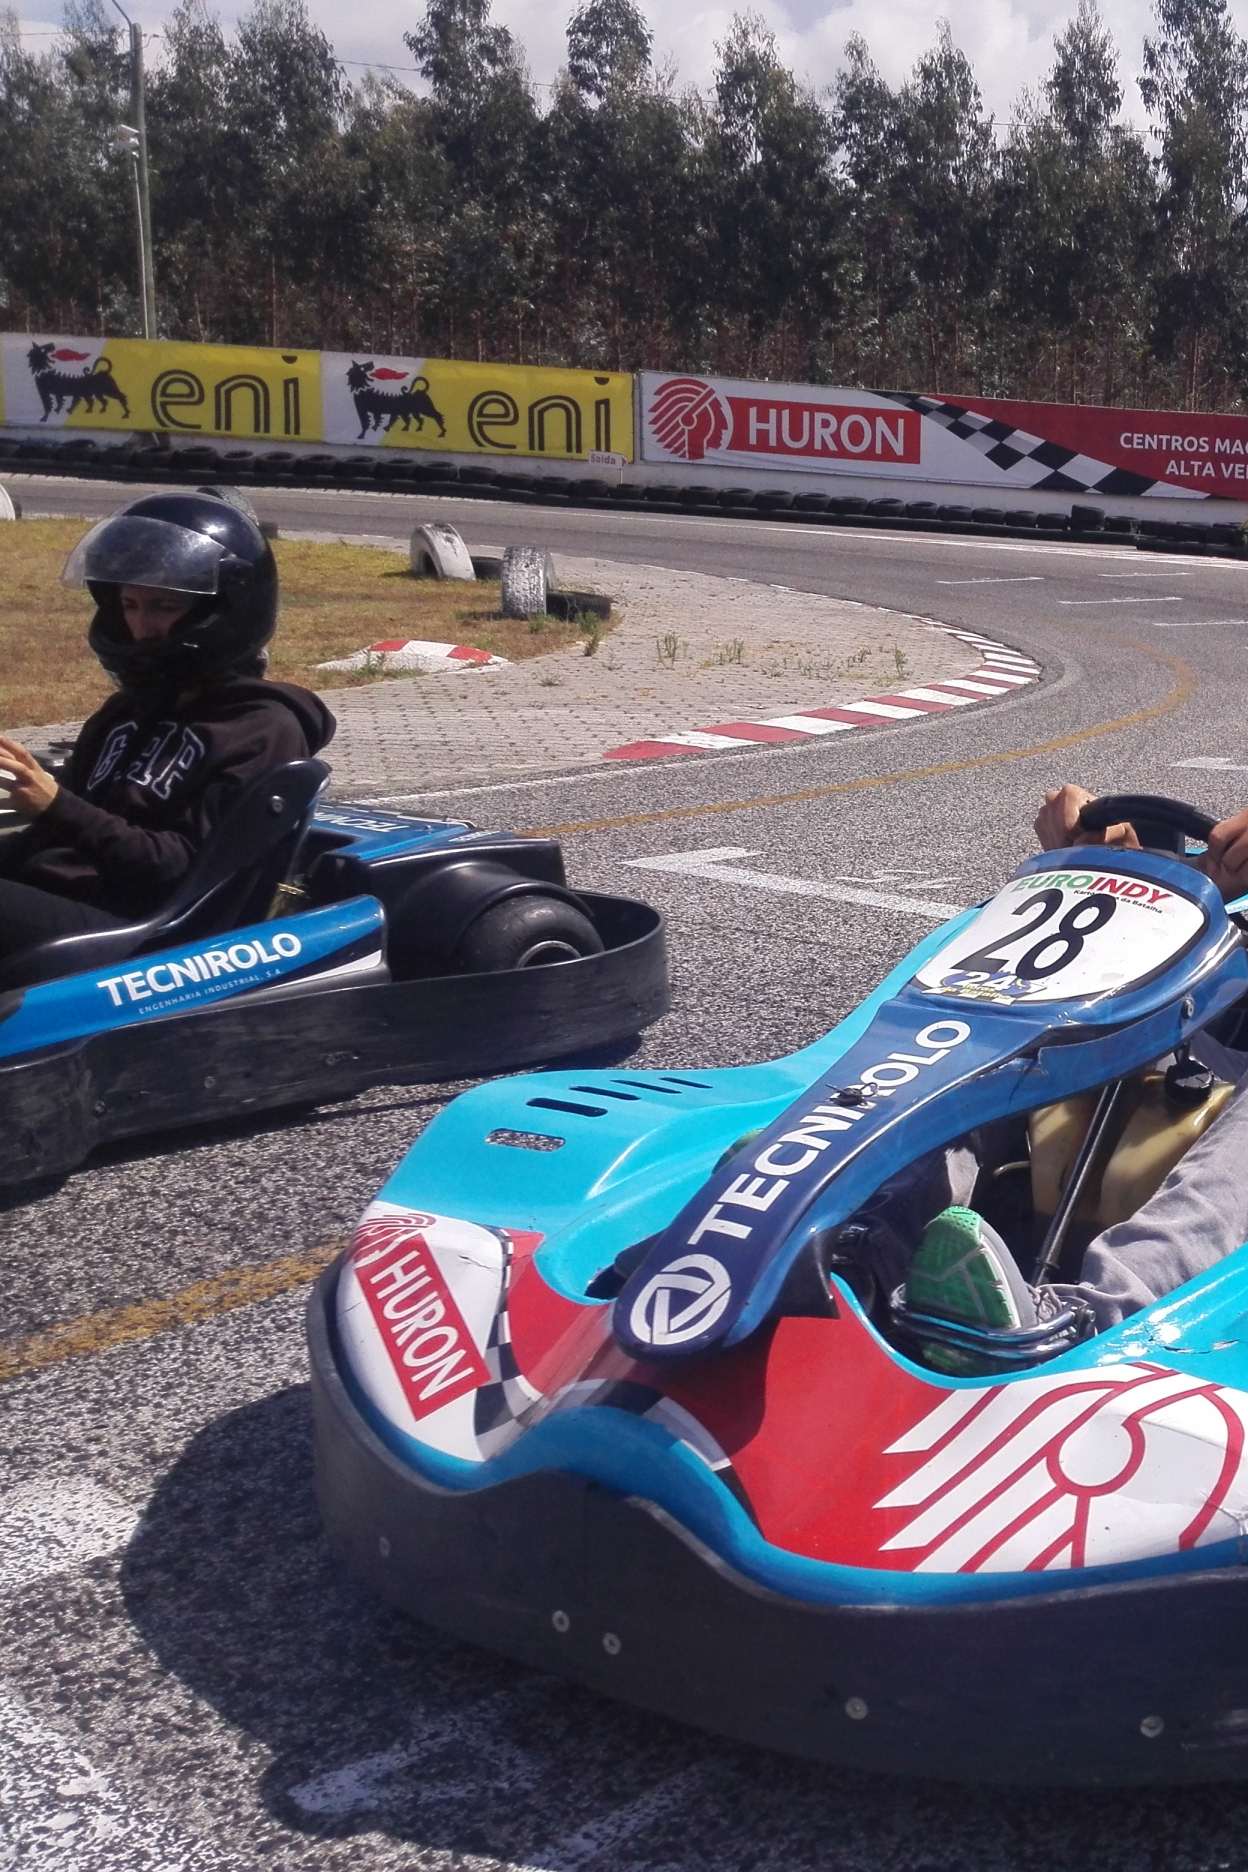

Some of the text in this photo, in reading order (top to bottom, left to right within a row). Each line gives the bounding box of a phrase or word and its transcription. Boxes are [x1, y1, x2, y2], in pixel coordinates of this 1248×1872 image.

[151, 355, 301, 435] eni
[467, 376, 612, 454] eni
[748, 407, 905, 457] HURON
[1120, 433, 1209, 453] CENTROS
[1165, 460, 1216, 477] ALTA
[1011, 873, 1174, 904] EUROINDY
[1132, 899, 1164, 914] Batalha
[951, 888, 1117, 982] 28
[97, 932, 302, 1007] TECNIROLO
[138, 990, 201, 1015] ENGENHARIA
[370, 1250, 476, 1401] HURON
